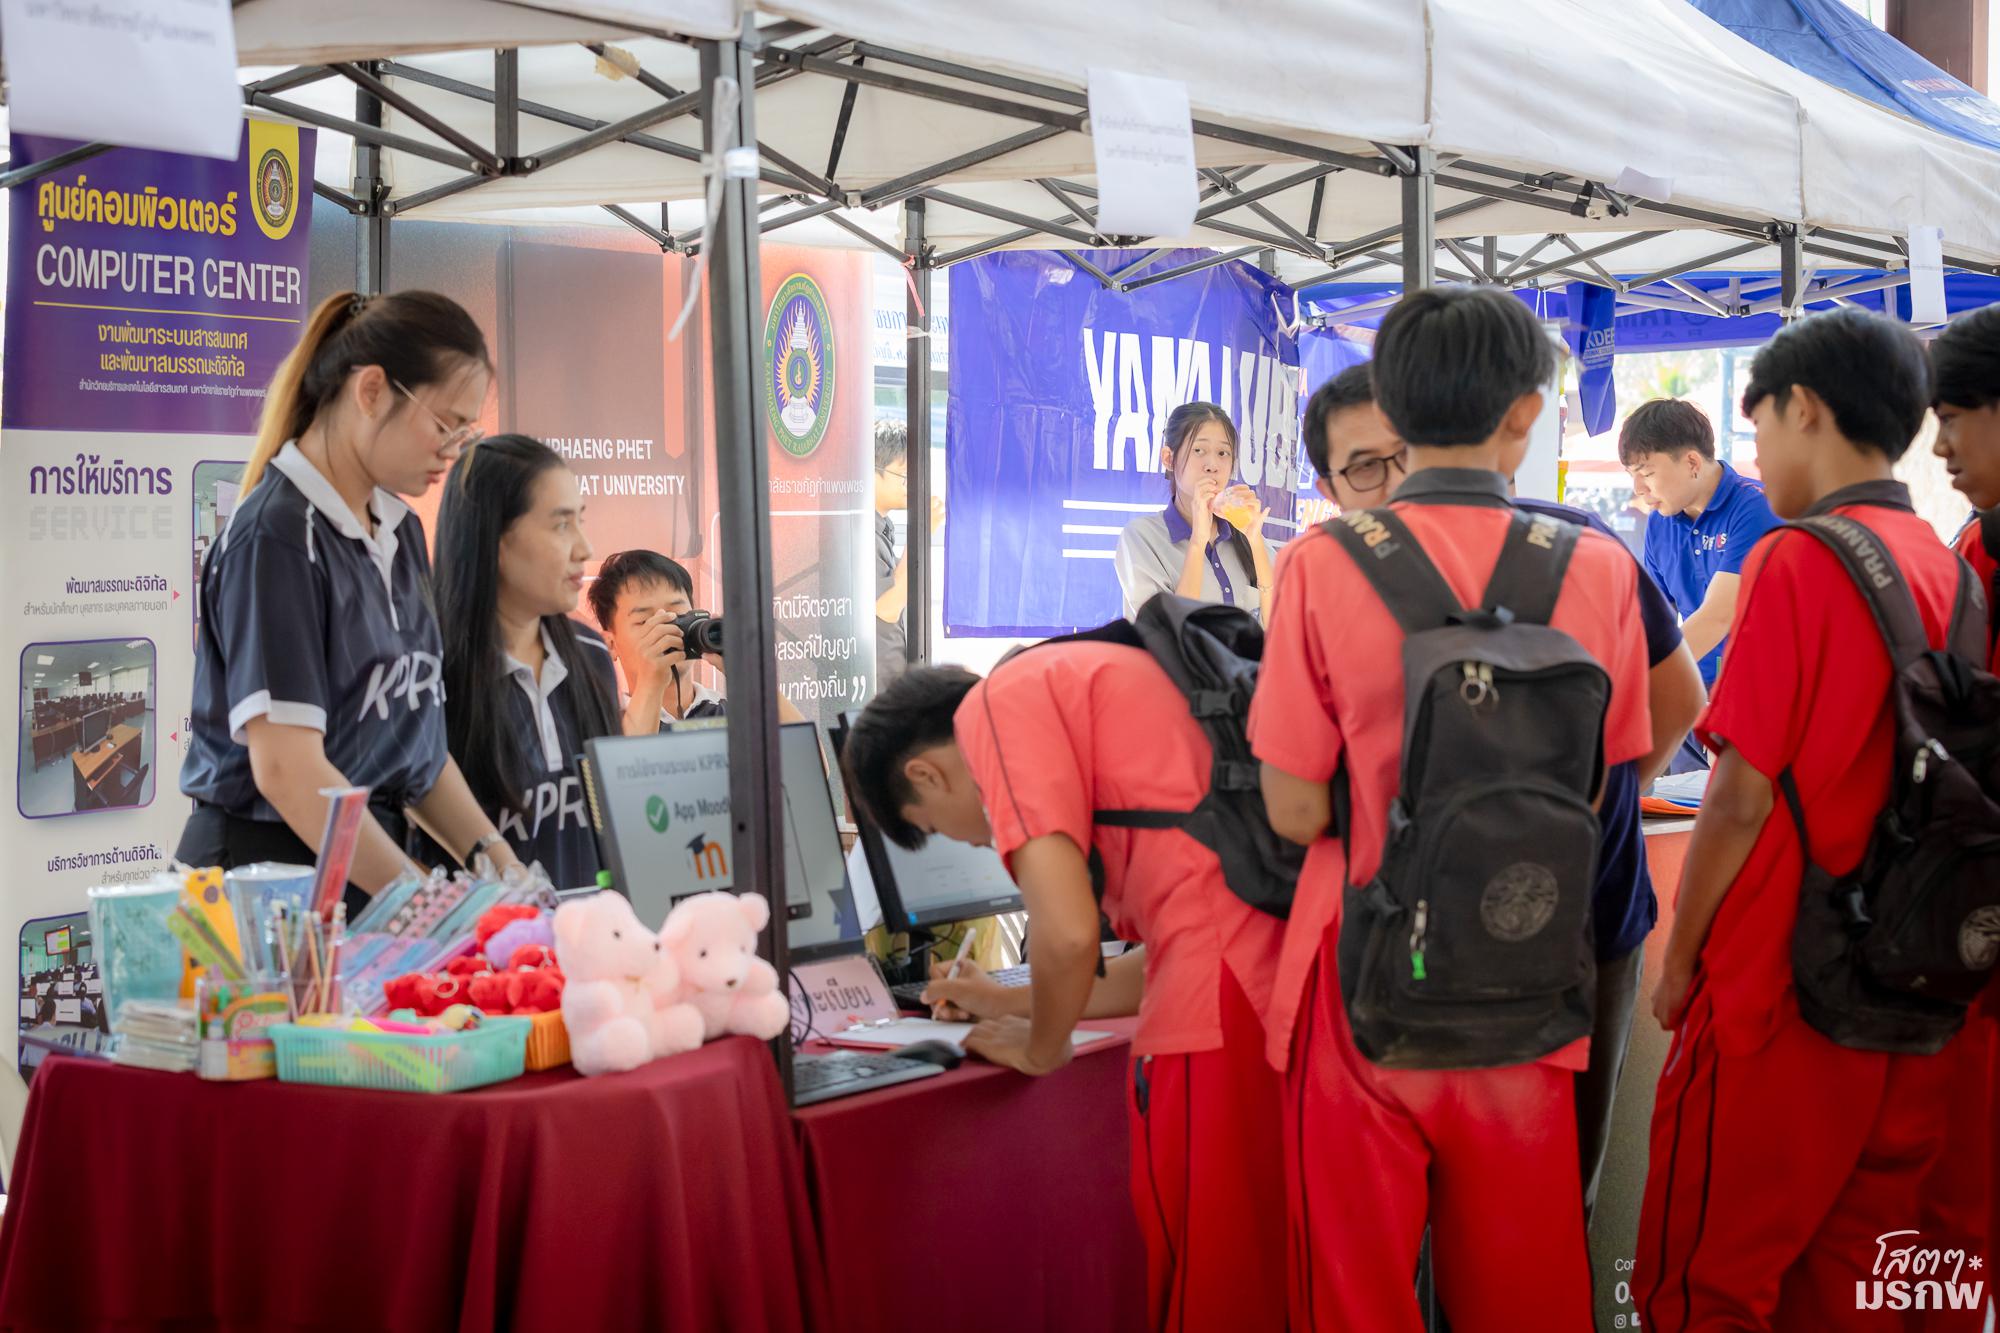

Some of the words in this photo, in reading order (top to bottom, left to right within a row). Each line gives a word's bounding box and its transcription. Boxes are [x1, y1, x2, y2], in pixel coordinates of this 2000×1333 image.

[38, 175, 238, 236] ศูนย์คอมพิวเตอร์
[36, 243, 195, 296] COMPUTER
[202, 257, 301, 305] CENTER
[98, 320, 248, 350] งานพัฒนาระบบสารสนเทศ
[100, 349, 246, 377] และพัฒนาสมรรถนะดิจิทัล
[617, 439, 653, 460] PHET
[30, 453, 173, 495] การให้บริการ
[603, 475, 685, 496] UNIVERSITY
[29, 505, 174, 541] SERVICE
[66, 574, 167, 594] พัฒนาสมรรถนะดิจิทัล
